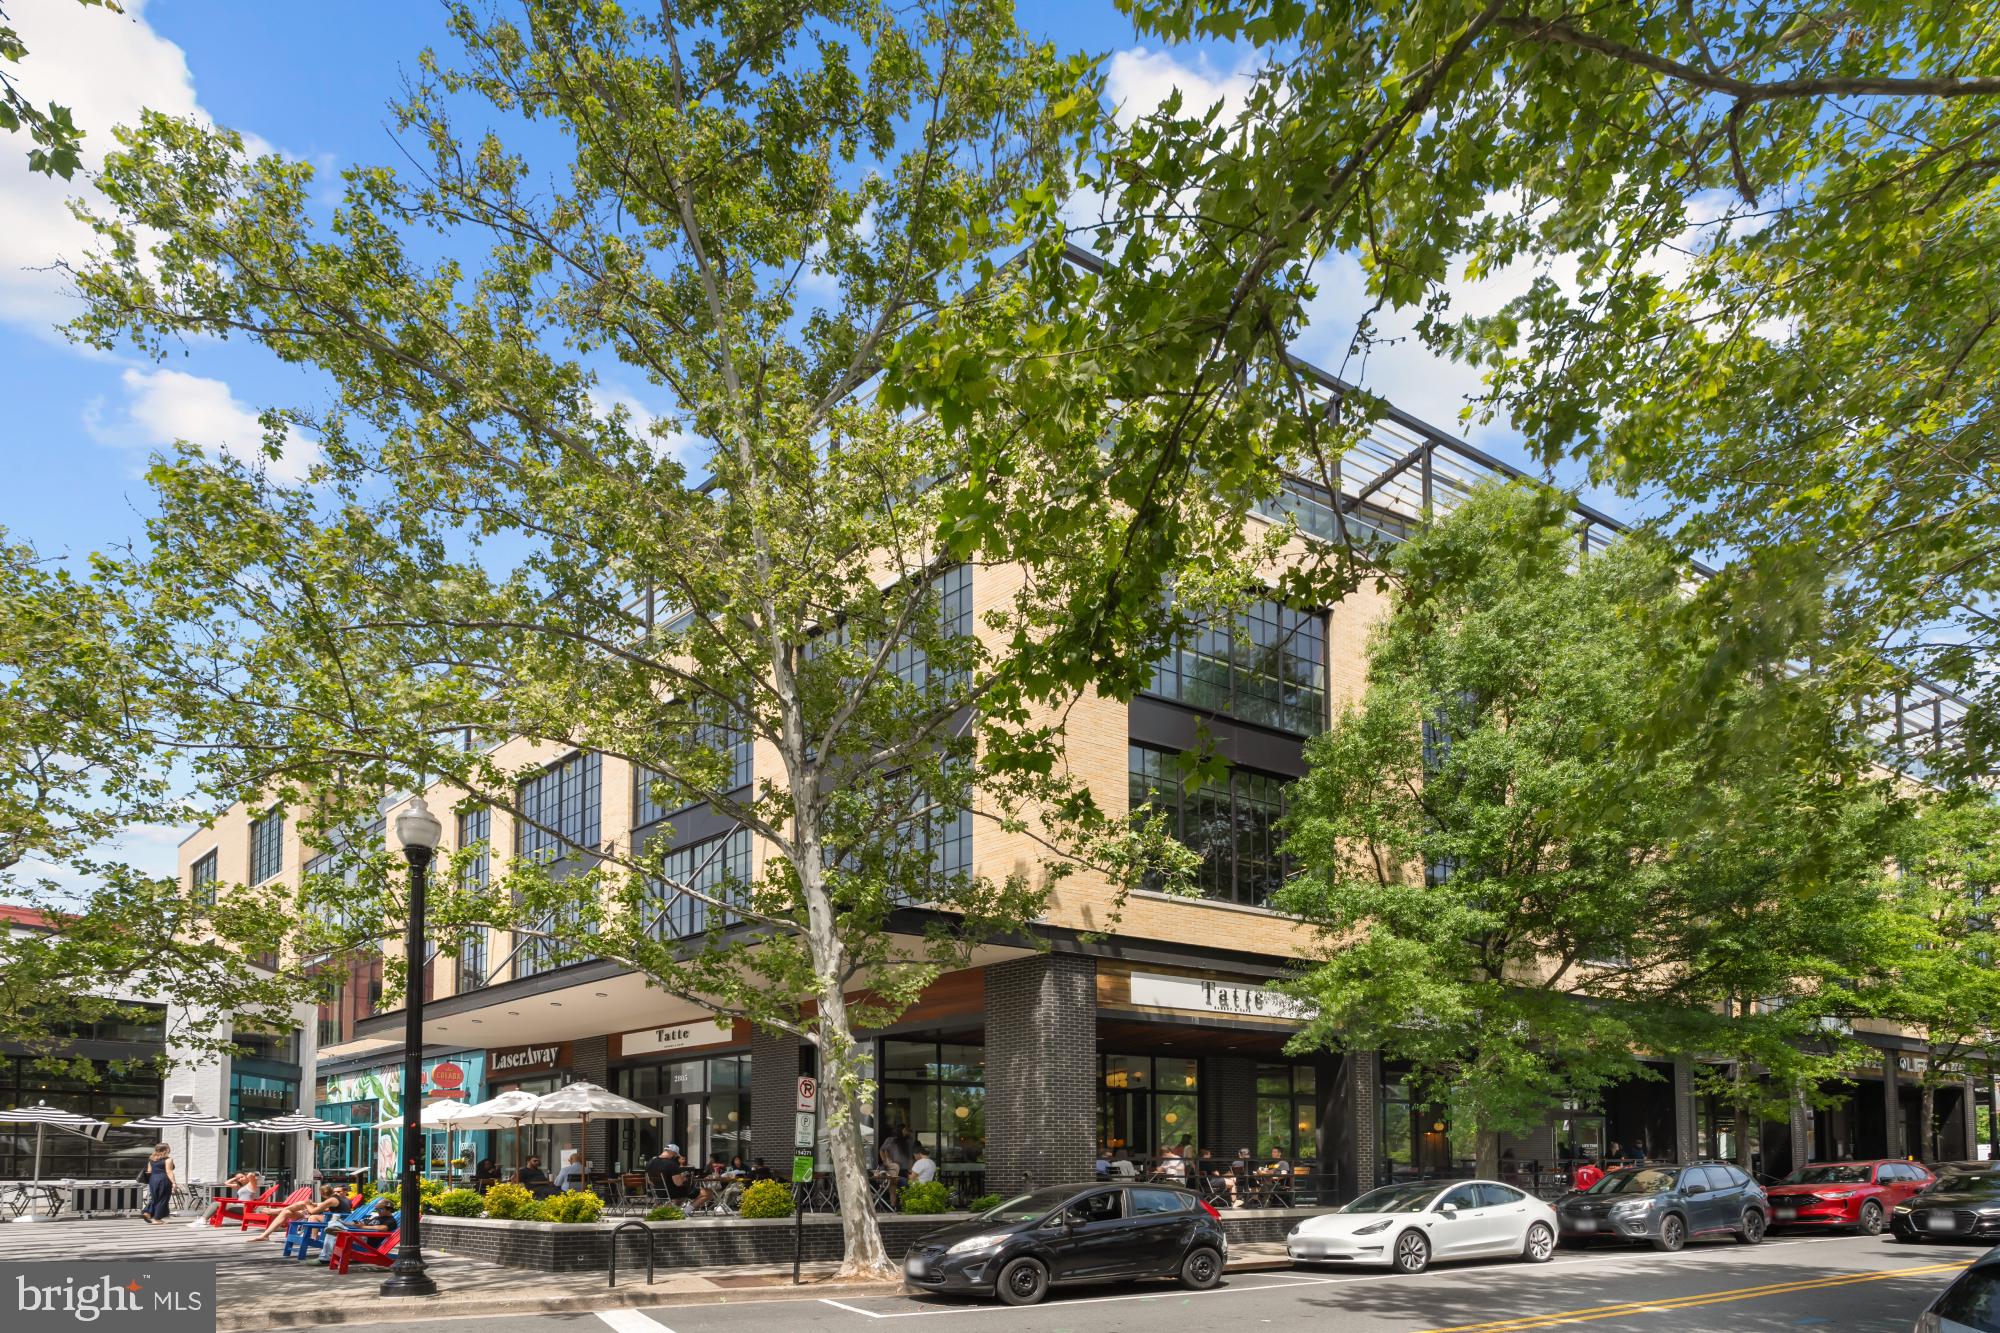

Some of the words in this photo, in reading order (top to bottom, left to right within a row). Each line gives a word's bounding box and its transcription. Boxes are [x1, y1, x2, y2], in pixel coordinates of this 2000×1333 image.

[1201, 981, 1264, 1010] Tatte
[656, 1029, 689, 1042] Tatte
[491, 1046, 559, 1071] LaserAway
